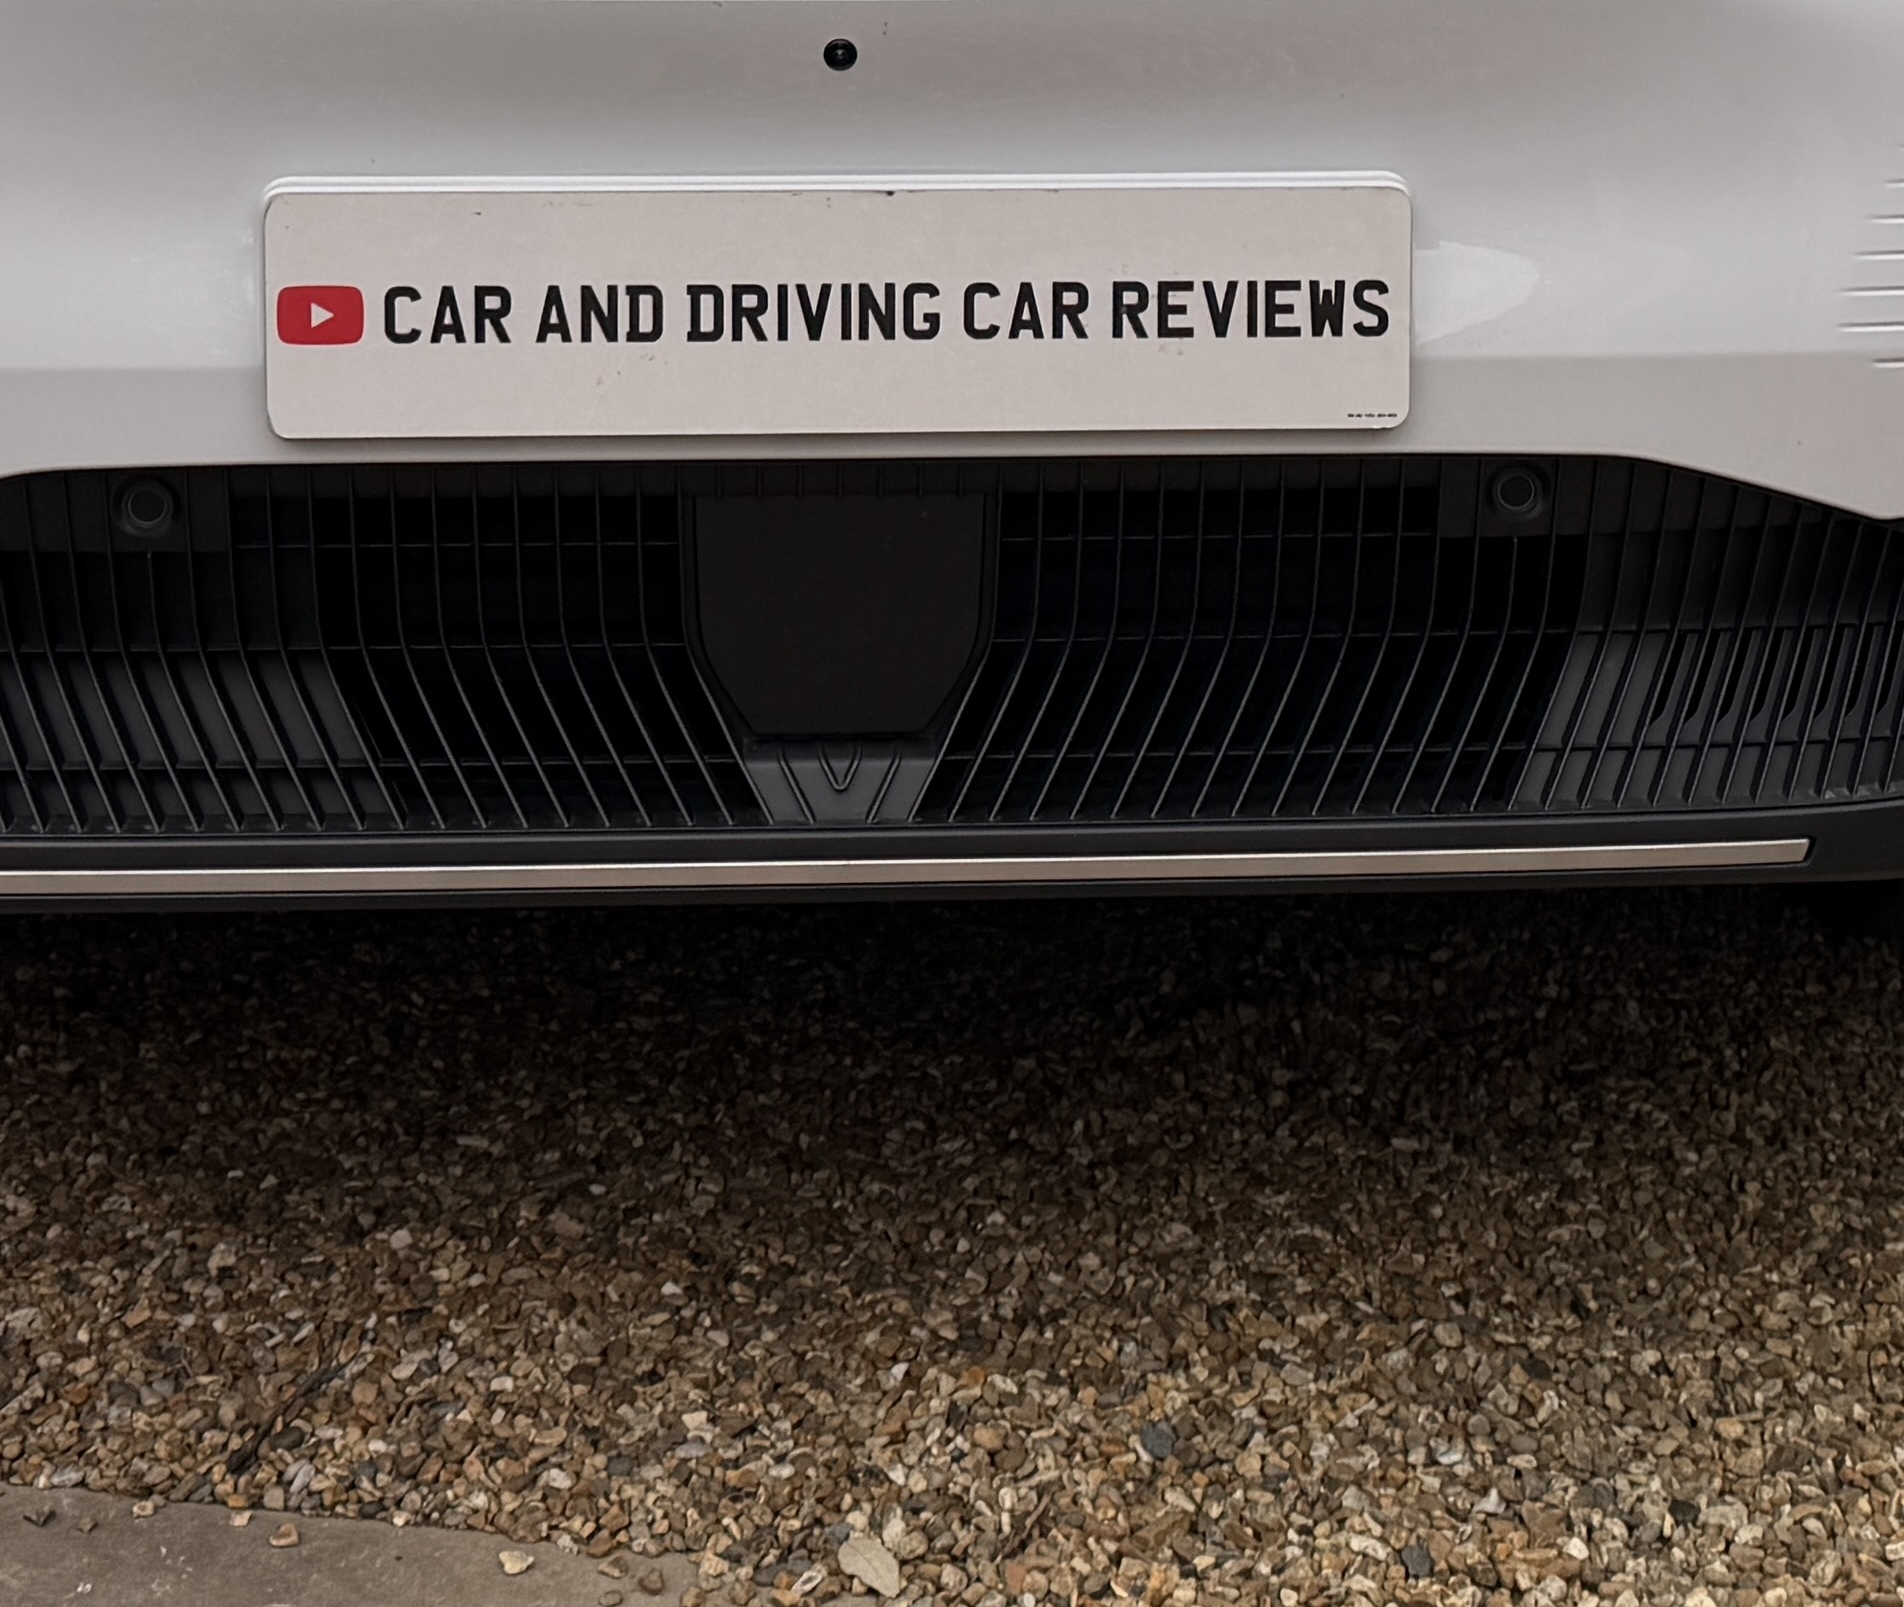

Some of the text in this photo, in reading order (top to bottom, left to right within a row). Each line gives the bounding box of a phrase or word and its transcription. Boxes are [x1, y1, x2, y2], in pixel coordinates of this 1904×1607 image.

[384, 279, 1389, 344] CAR AND DRIVING CAR REVIEWS
